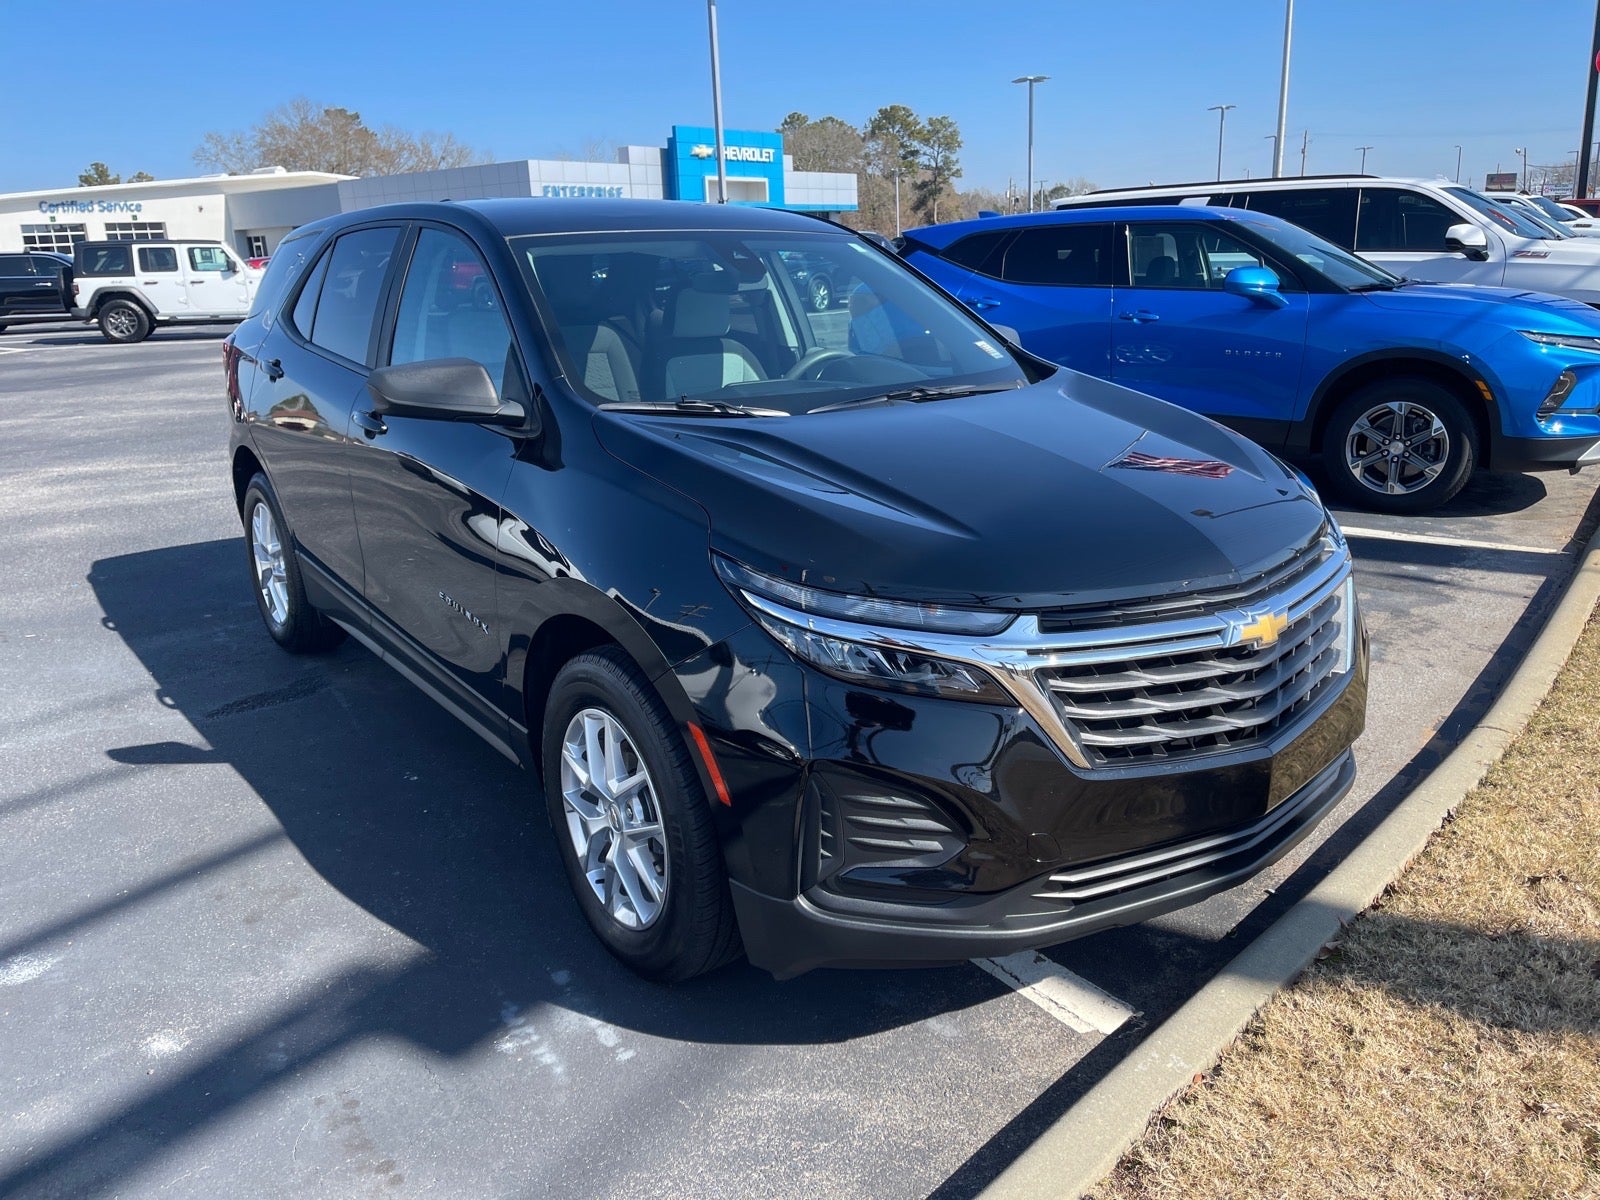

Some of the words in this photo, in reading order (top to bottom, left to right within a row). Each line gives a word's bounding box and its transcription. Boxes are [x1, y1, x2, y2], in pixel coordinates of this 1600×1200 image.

[715, 145, 775, 163] HEVROLET
[543, 185, 622, 199] ENTERPRISE
[39, 200, 94, 214] Certified
[98, 201, 142, 213] Service
[1225, 349, 1282, 358] BLAZER
[439, 591, 489, 635] EQUINOX
